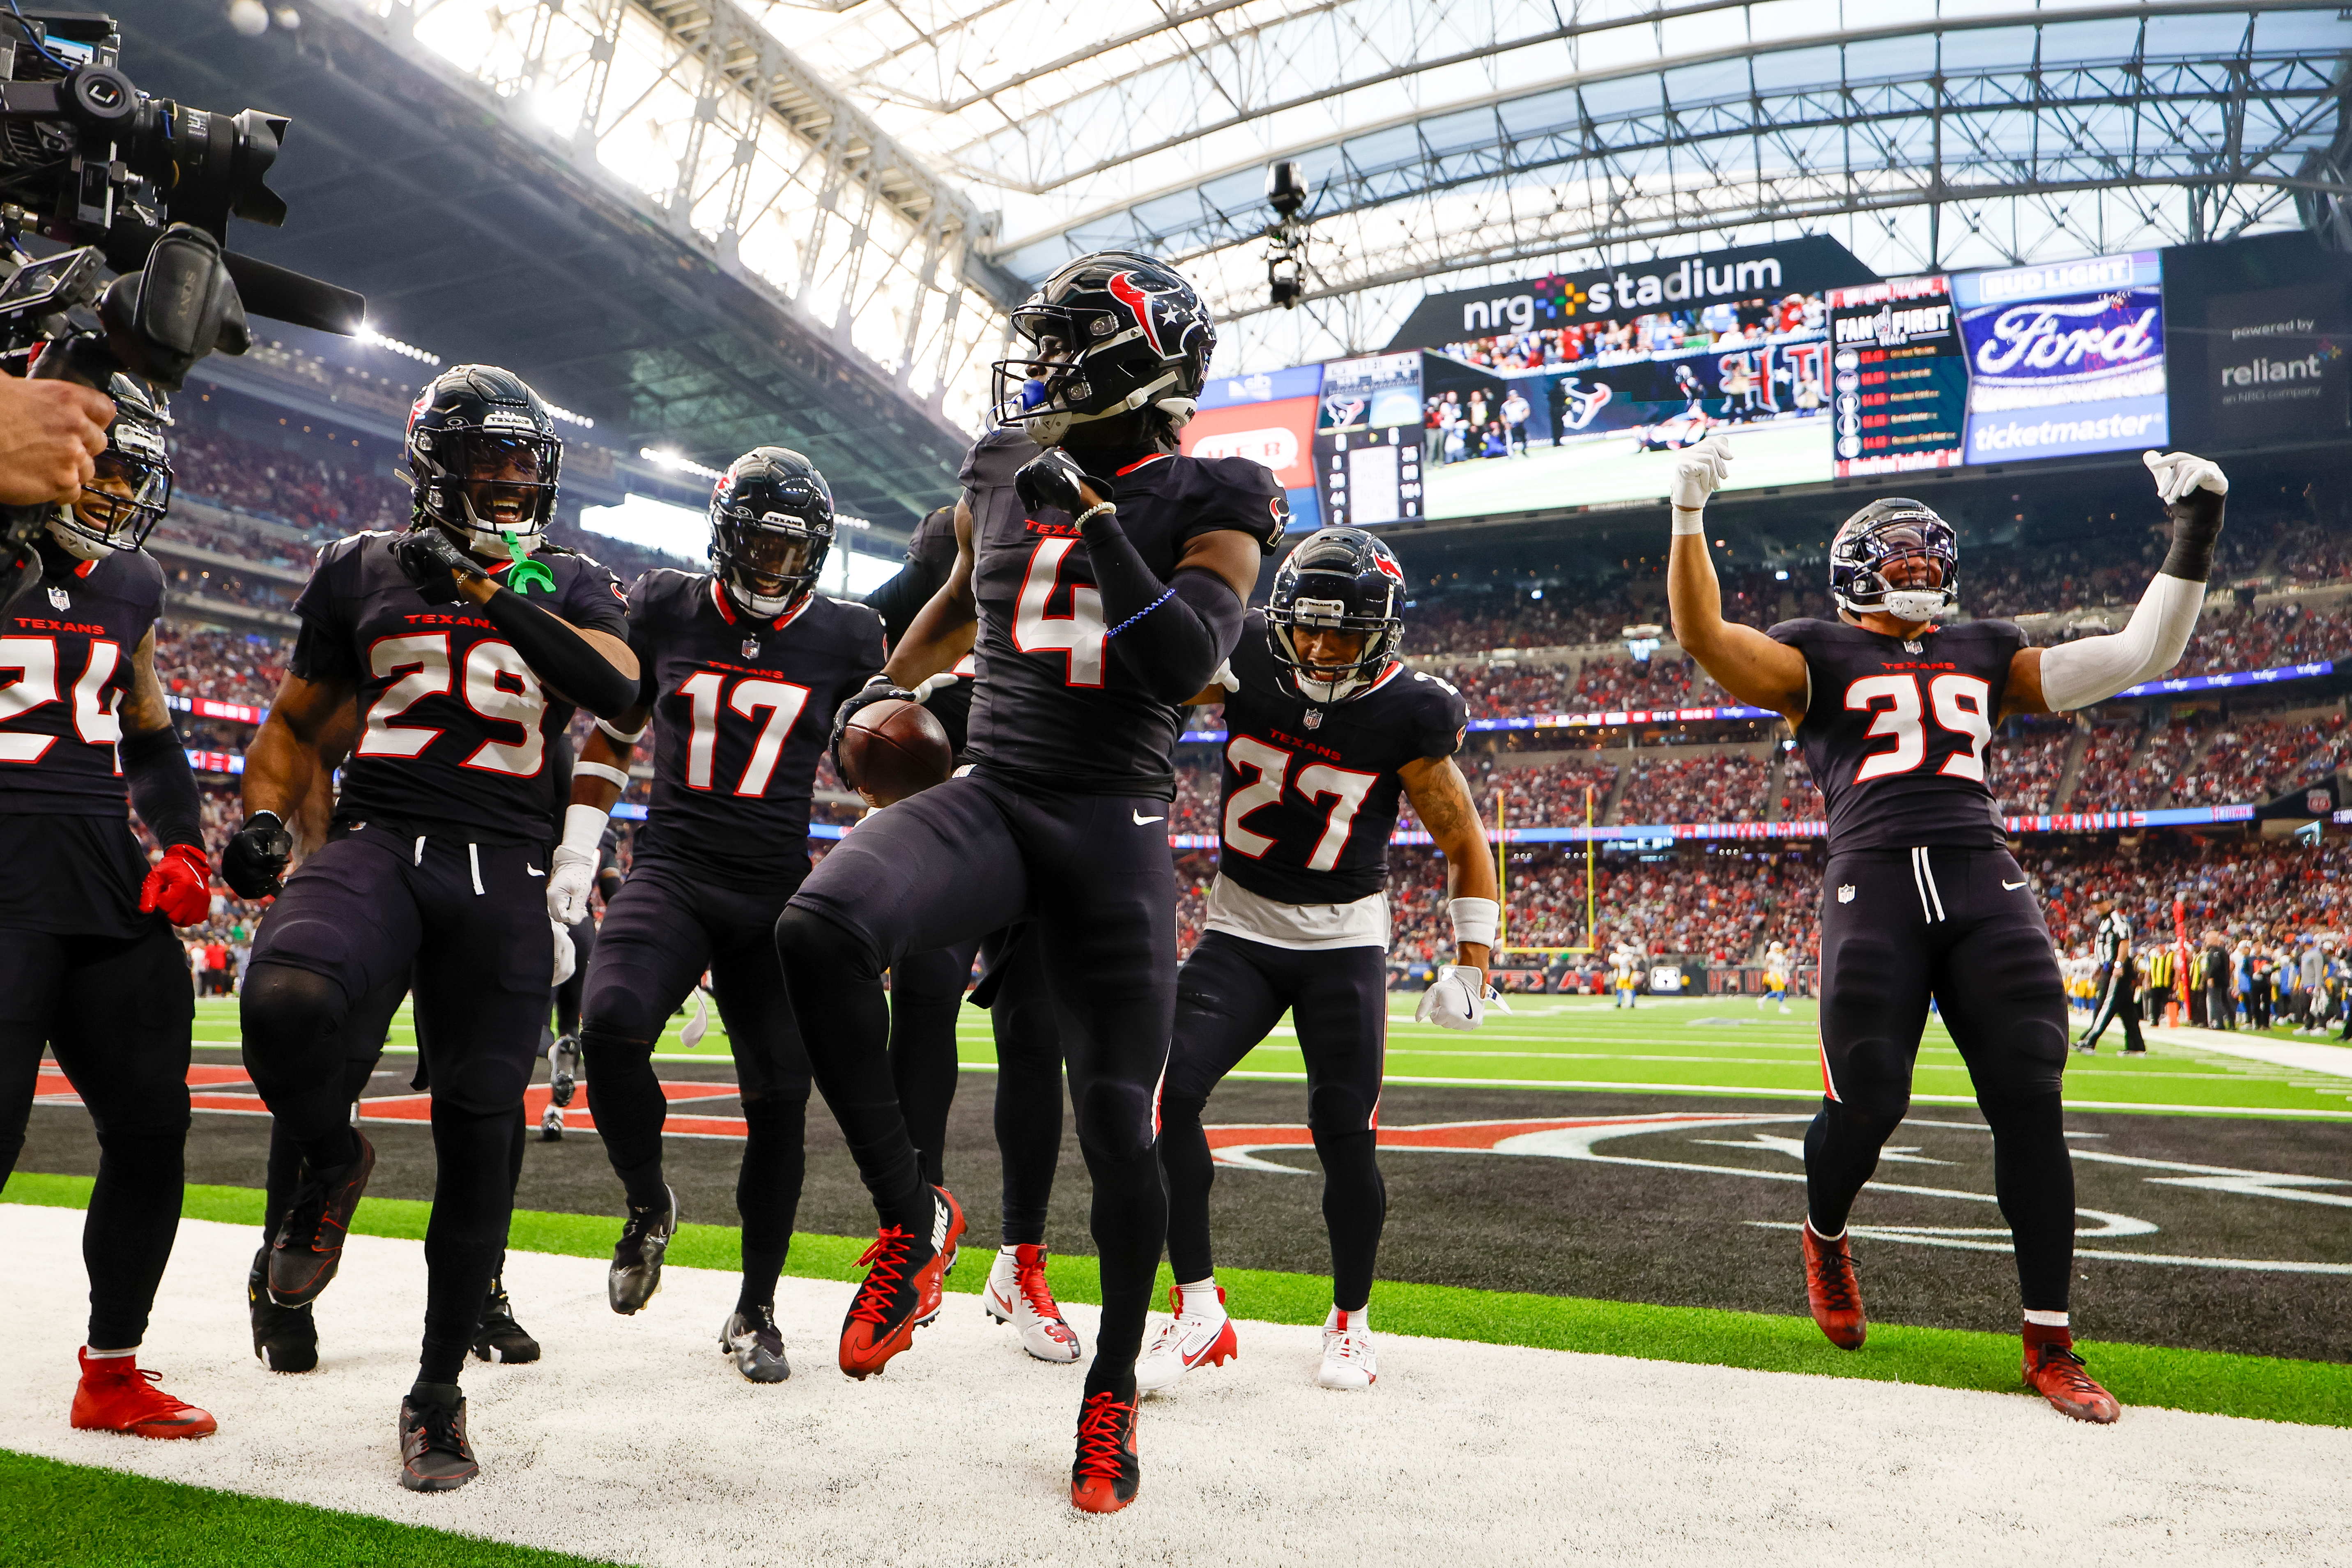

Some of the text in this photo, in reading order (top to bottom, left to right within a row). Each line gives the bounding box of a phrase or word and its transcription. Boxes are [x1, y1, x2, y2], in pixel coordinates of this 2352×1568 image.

[1588, 257, 1782, 314] stadium
[1985, 260, 2127, 297] BUD LIGHT
[1464, 294, 1535, 334] nrg
[1835, 305, 1951, 343] FAN FIRST
[2232, 318, 2314, 341] powered by
[1977, 299, 2157, 374] Ford
[1244, 372, 1272, 391] slb
[2221, 354, 2322, 387] reliant
[1975, 412, 2153, 451] ticketmaster
[1330, 491, 1346, 506] 44
[1400, 483, 1422, 499] 104
[1024, 519, 1083, 536] TEXA
[53, 596, 67, 607] NFL
[1012, 535, 1108, 689] 4
[14, 618, 105, 635] TEXANS
[404, 614, 498, 631] TEXAN
[706, 660, 784, 679] TEXANS
[0, 635, 128, 776] 24
[355, 630, 549, 779] 29
[1306, 717, 1317, 726] NFL
[675, 670, 812, 798] 17
[1270, 728, 1341, 761] TEXANS
[1843, 672, 1992, 785] 39
[1223, 733, 1380, 872] 27
[930, 1195, 948, 1258] NIKE
